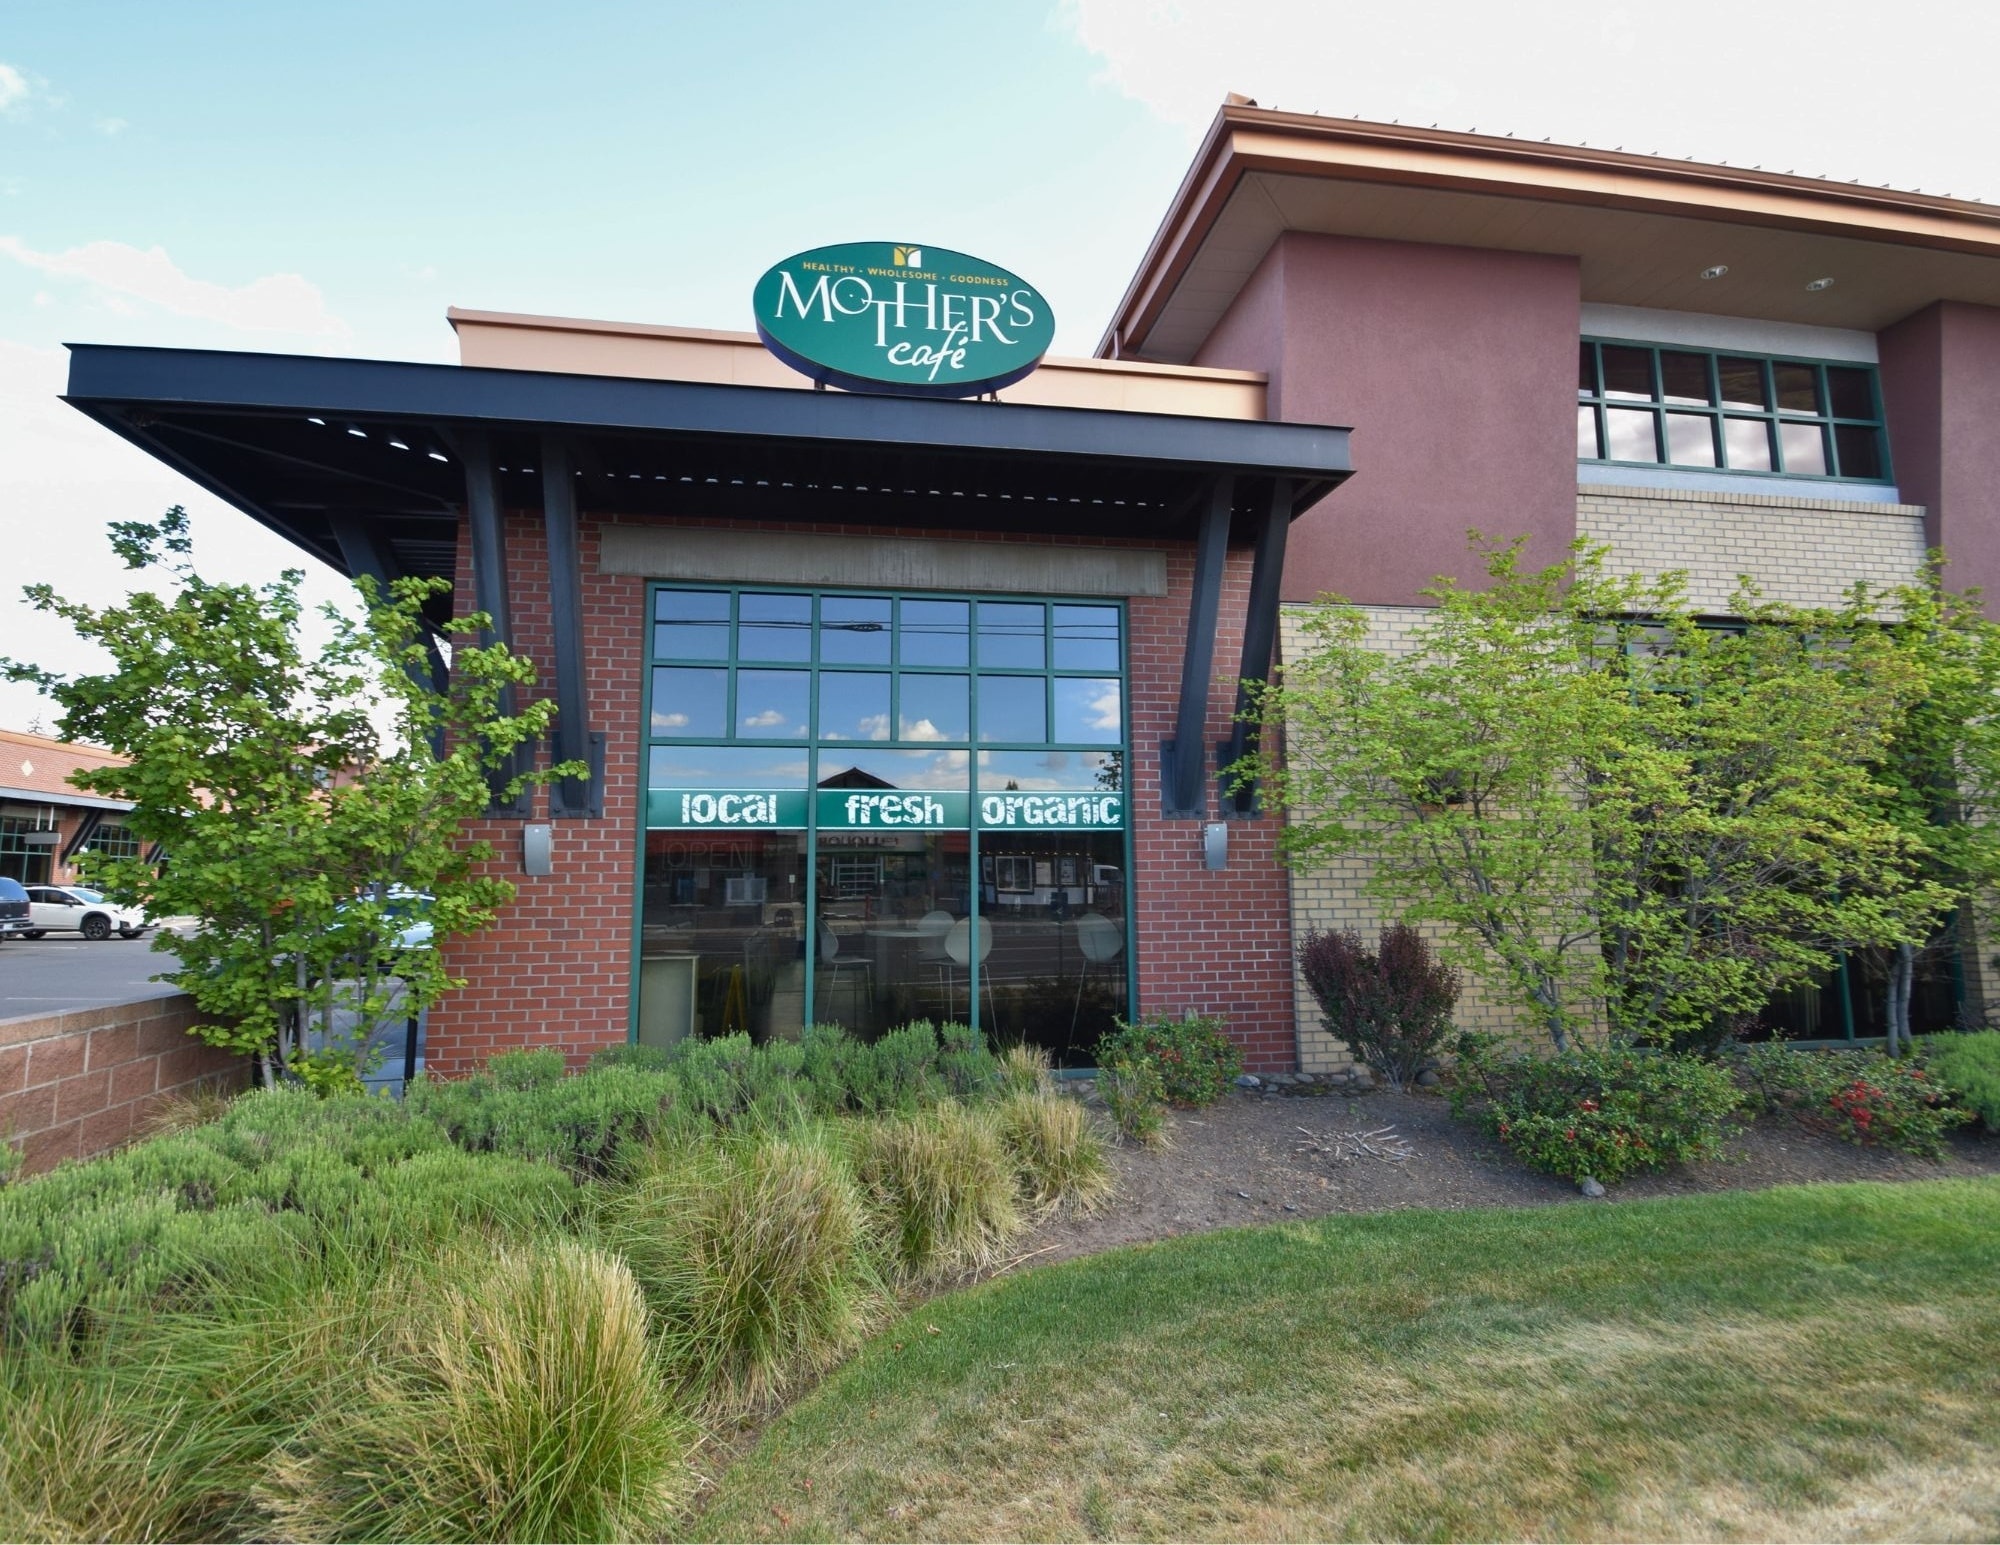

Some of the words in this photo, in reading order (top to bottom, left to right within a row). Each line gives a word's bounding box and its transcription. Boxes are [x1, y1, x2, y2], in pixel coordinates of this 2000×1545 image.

[803, 261, 855, 274] HEALTHY
[867, 267, 938, 281] WHOLESOME
[950, 274, 1009, 287] GOODNESS
[774, 271, 1035, 347] MOTHER'S
[887, 320, 969, 382] café
[681, 793, 778, 824] local
[844, 794, 945, 825] fresh
[667, 842, 748, 868] OPEN
